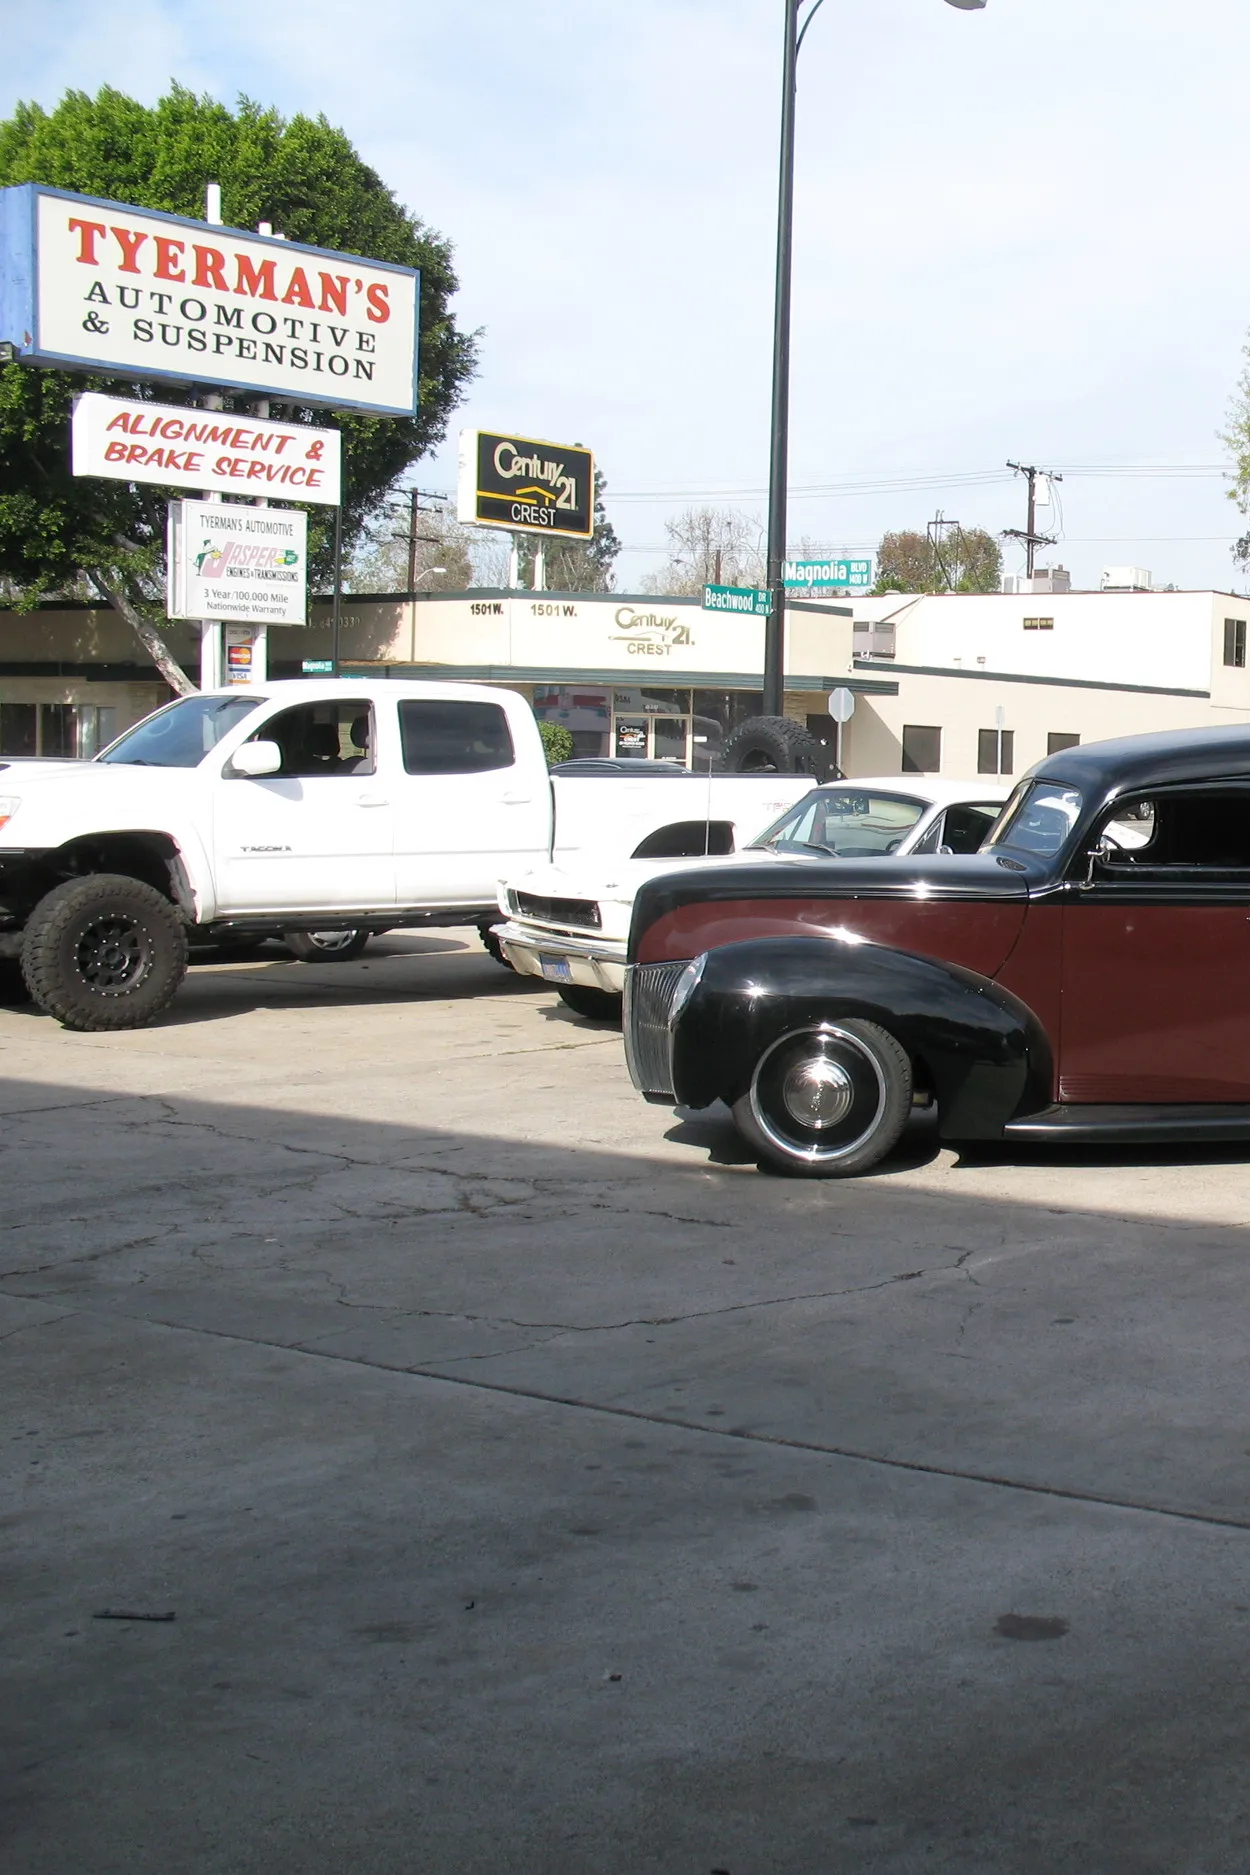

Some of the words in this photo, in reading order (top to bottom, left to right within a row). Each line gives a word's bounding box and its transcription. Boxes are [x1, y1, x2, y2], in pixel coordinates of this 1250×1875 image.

[68, 217, 391, 324] TYERMAN'S
[83, 280, 376, 353] AUTOMOTIVE
[82, 310, 110, 334] &
[133, 319, 376, 381] SUSPENSION
[106, 412, 296, 454] ALIGNMENT
[305, 439, 325, 461] &
[104, 441, 205, 472] BRAKE
[211, 456, 325, 487] SERVICE
[494, 441, 564, 487] Century
[200, 514, 243, 532] TYERMAN'S
[245, 519, 294, 537] AUTOMOTIVE
[511, 503, 556, 526] CREST
[201, 541, 279, 579] JASPER
[226, 566, 250, 579] ENGINES
[254, 568, 299, 582] TRANSMISSIONS
[785, 561, 847, 587] Magnolia
[850, 562, 868, 573] BLVD
[204, 588, 209, 598] 3
[270, 593, 289, 604] Mile
[206, 601, 250, 613] Nationwide
[251, 604, 287, 616] Warranty
[705, 587, 754, 612] Beachwood
[758, 592, 767, 603] DR
[530, 604, 560, 617] 1501
[615, 607, 678, 631] Century
[627, 643, 672, 656] CREST
